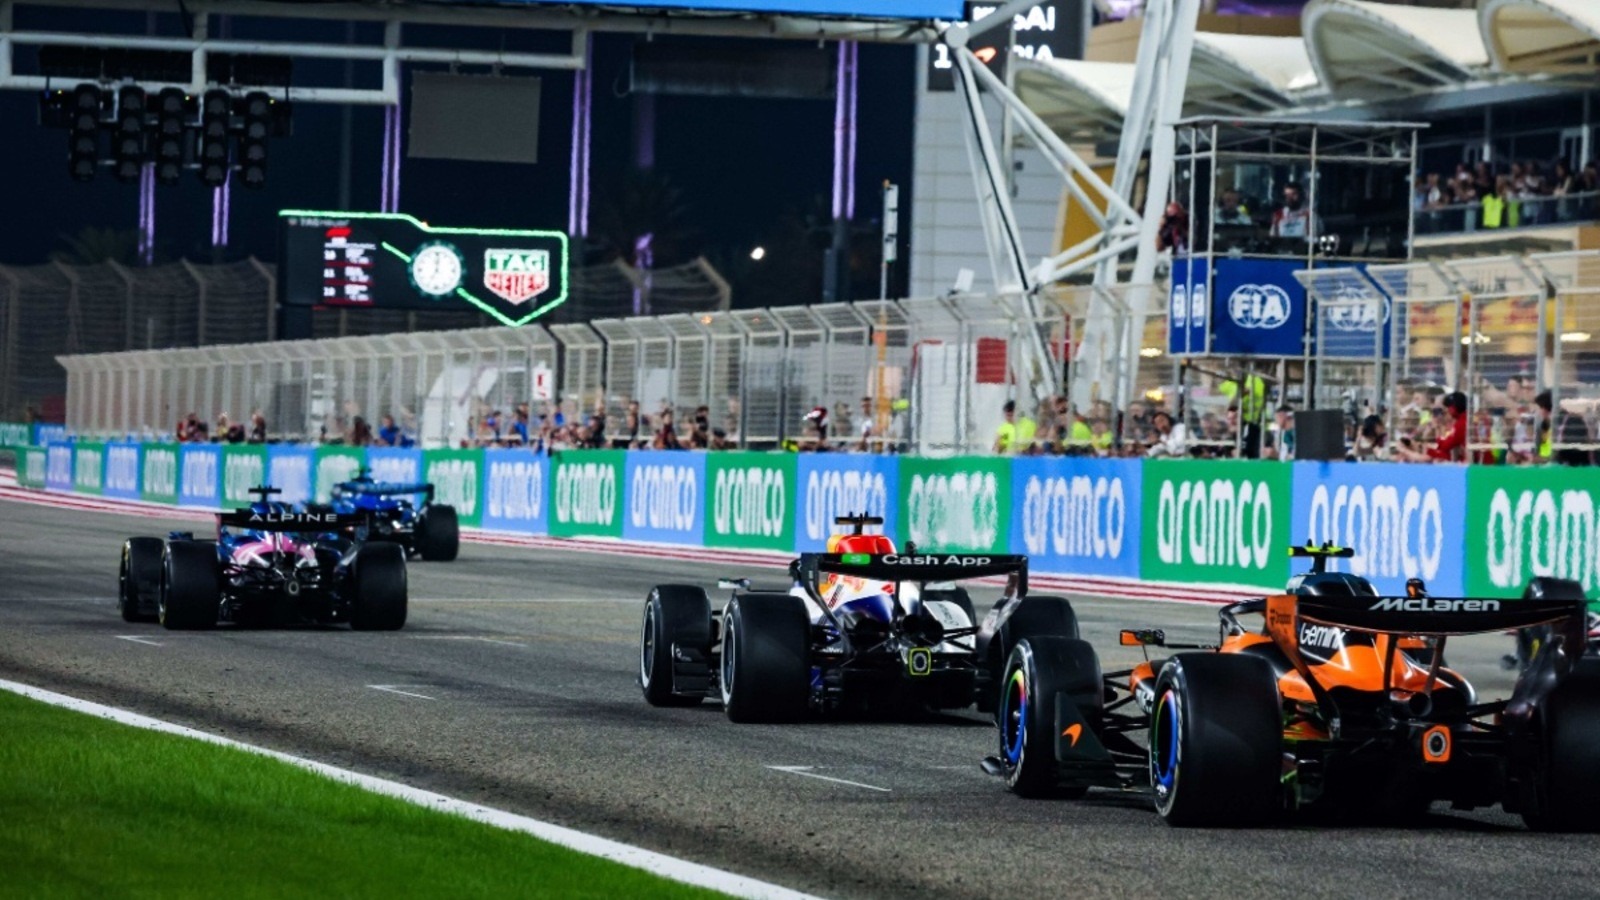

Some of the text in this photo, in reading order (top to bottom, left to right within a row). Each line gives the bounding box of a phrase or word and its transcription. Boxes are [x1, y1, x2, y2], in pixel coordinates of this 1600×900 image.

[490, 253, 542, 271] TAG
[1232, 293, 1286, 320] FIA
[249, 513, 338, 522] ALPINE
[555, 463, 616, 526] aramco
[631, 464, 697, 531] aramco
[714, 467, 785, 537] aramco
[1023, 475, 1125, 559] aramco
[1157, 479, 1272, 569] aramco
[882, 554, 991, 567] Cash App
[1309, 484, 1443, 581] aramco
[1486, 488, 1600, 593] aram
[1369, 598, 1500, 612] McLaren
